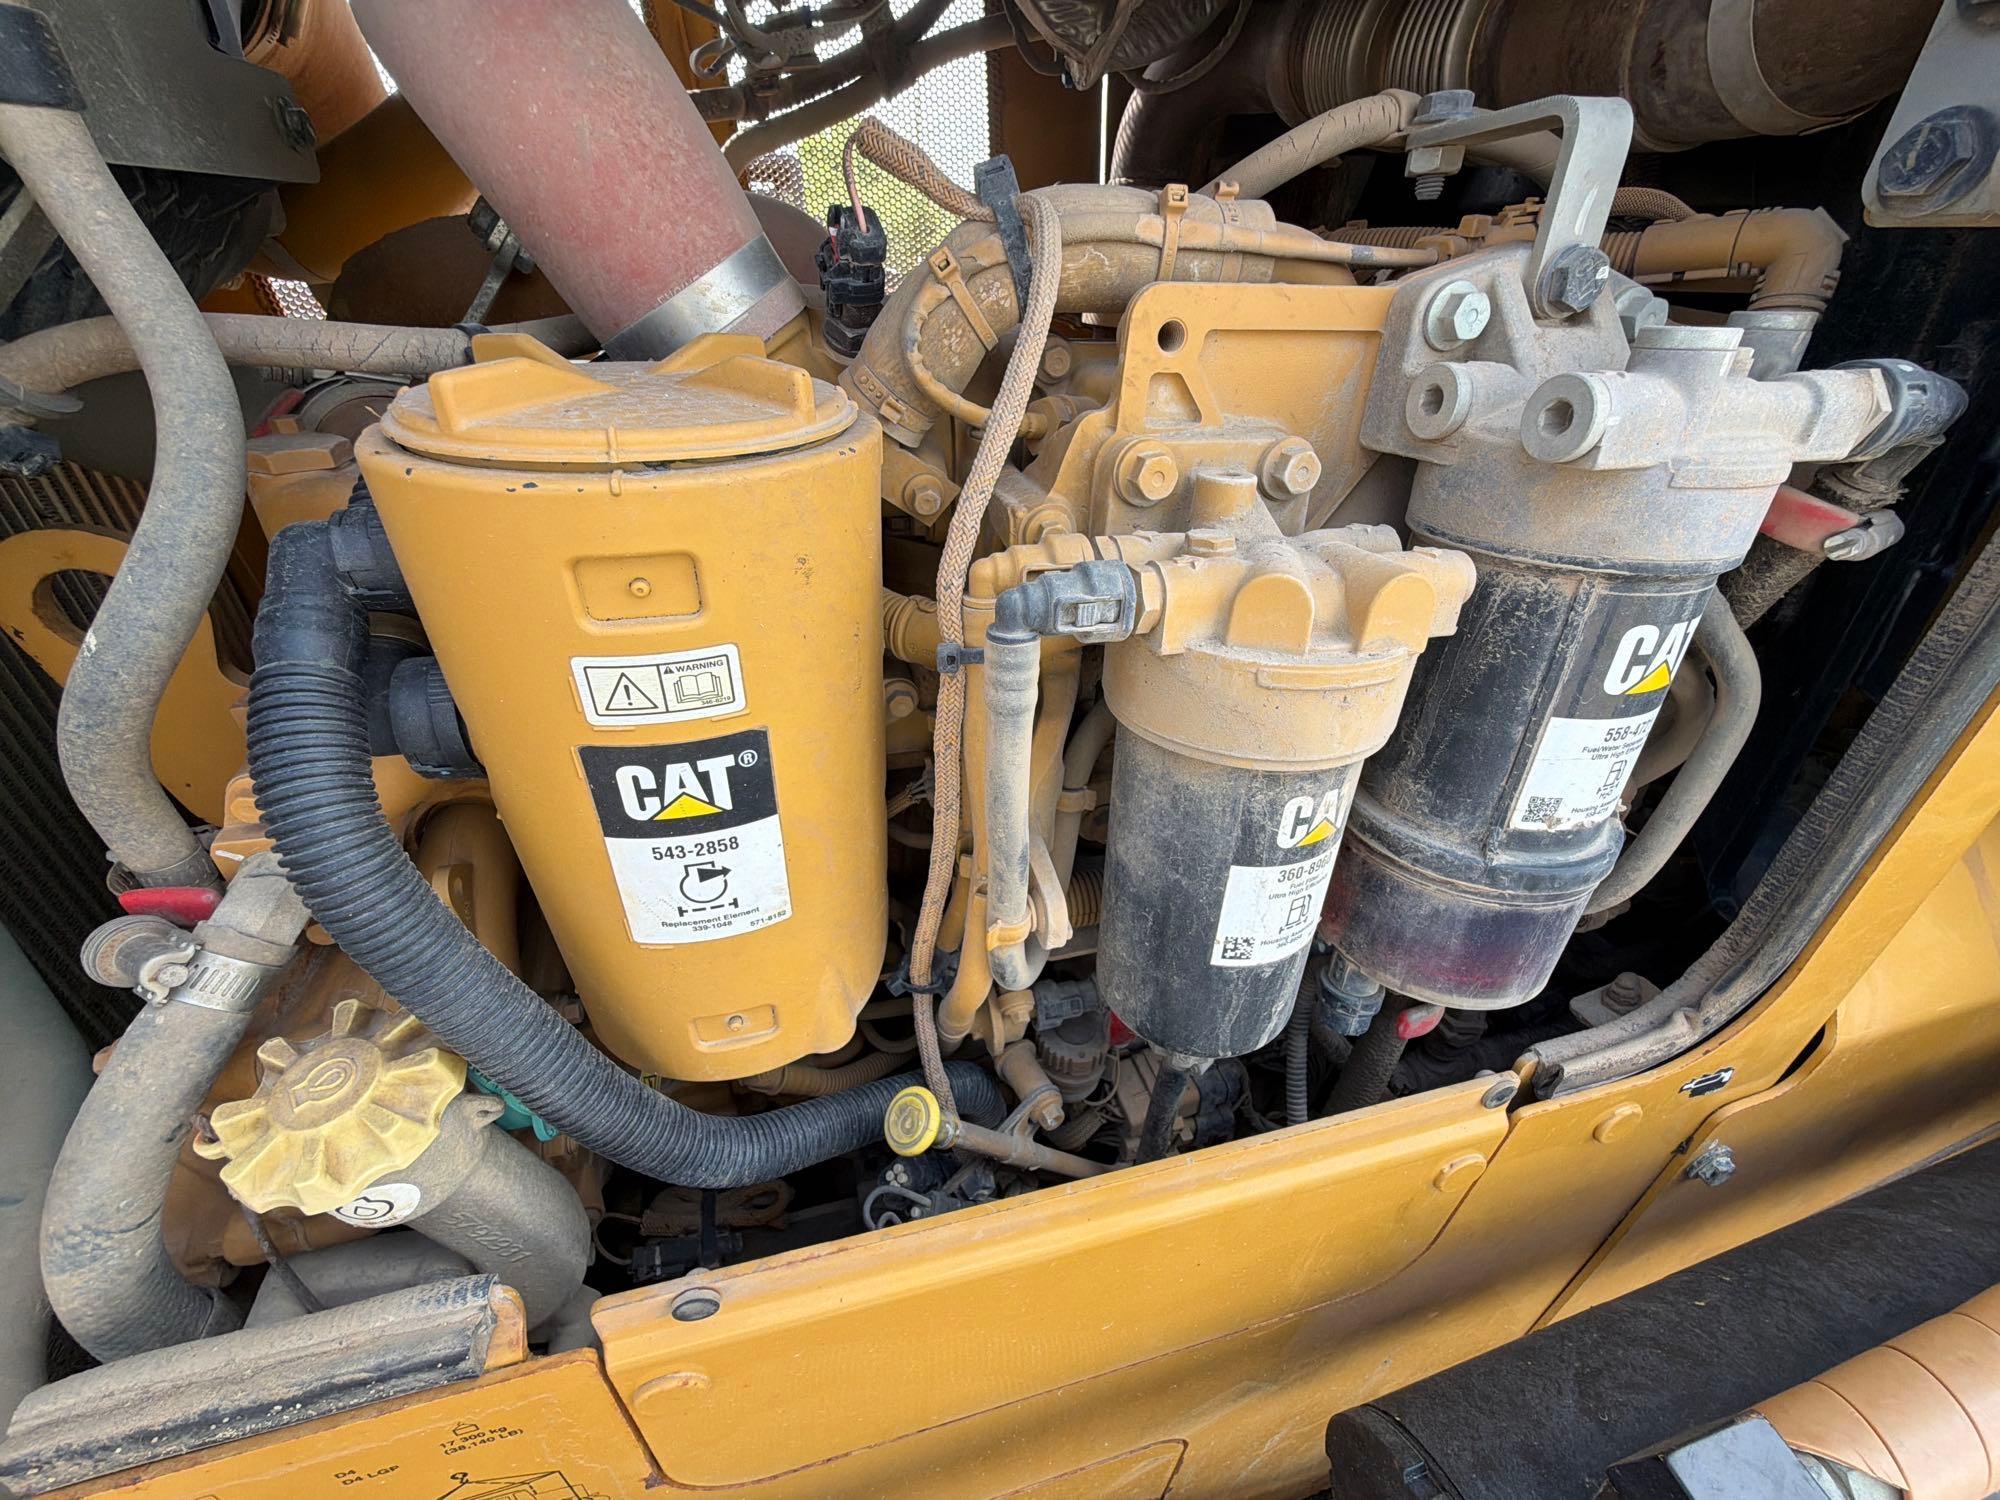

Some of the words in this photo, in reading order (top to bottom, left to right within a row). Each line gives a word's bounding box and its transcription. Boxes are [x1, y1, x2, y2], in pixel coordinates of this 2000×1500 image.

[675, 659, 724, 673] WARNING
[651, 836, 740, 861] 543-2858
[661, 915, 721, 928] Replacement
[723, 906, 760, 921] Element
[691, 920, 733, 932] 339-1048
[439, 1440, 456, 1449] 17
[464, 1431, 486, 1444] 300
[490, 1426, 508, 1435] kg
[498, 1428, 525, 1440] LB)
[334, 1469, 357, 1480] D4
[341, 1476, 364, 1486] D4
[366, 1464, 400, 1479] LGP
